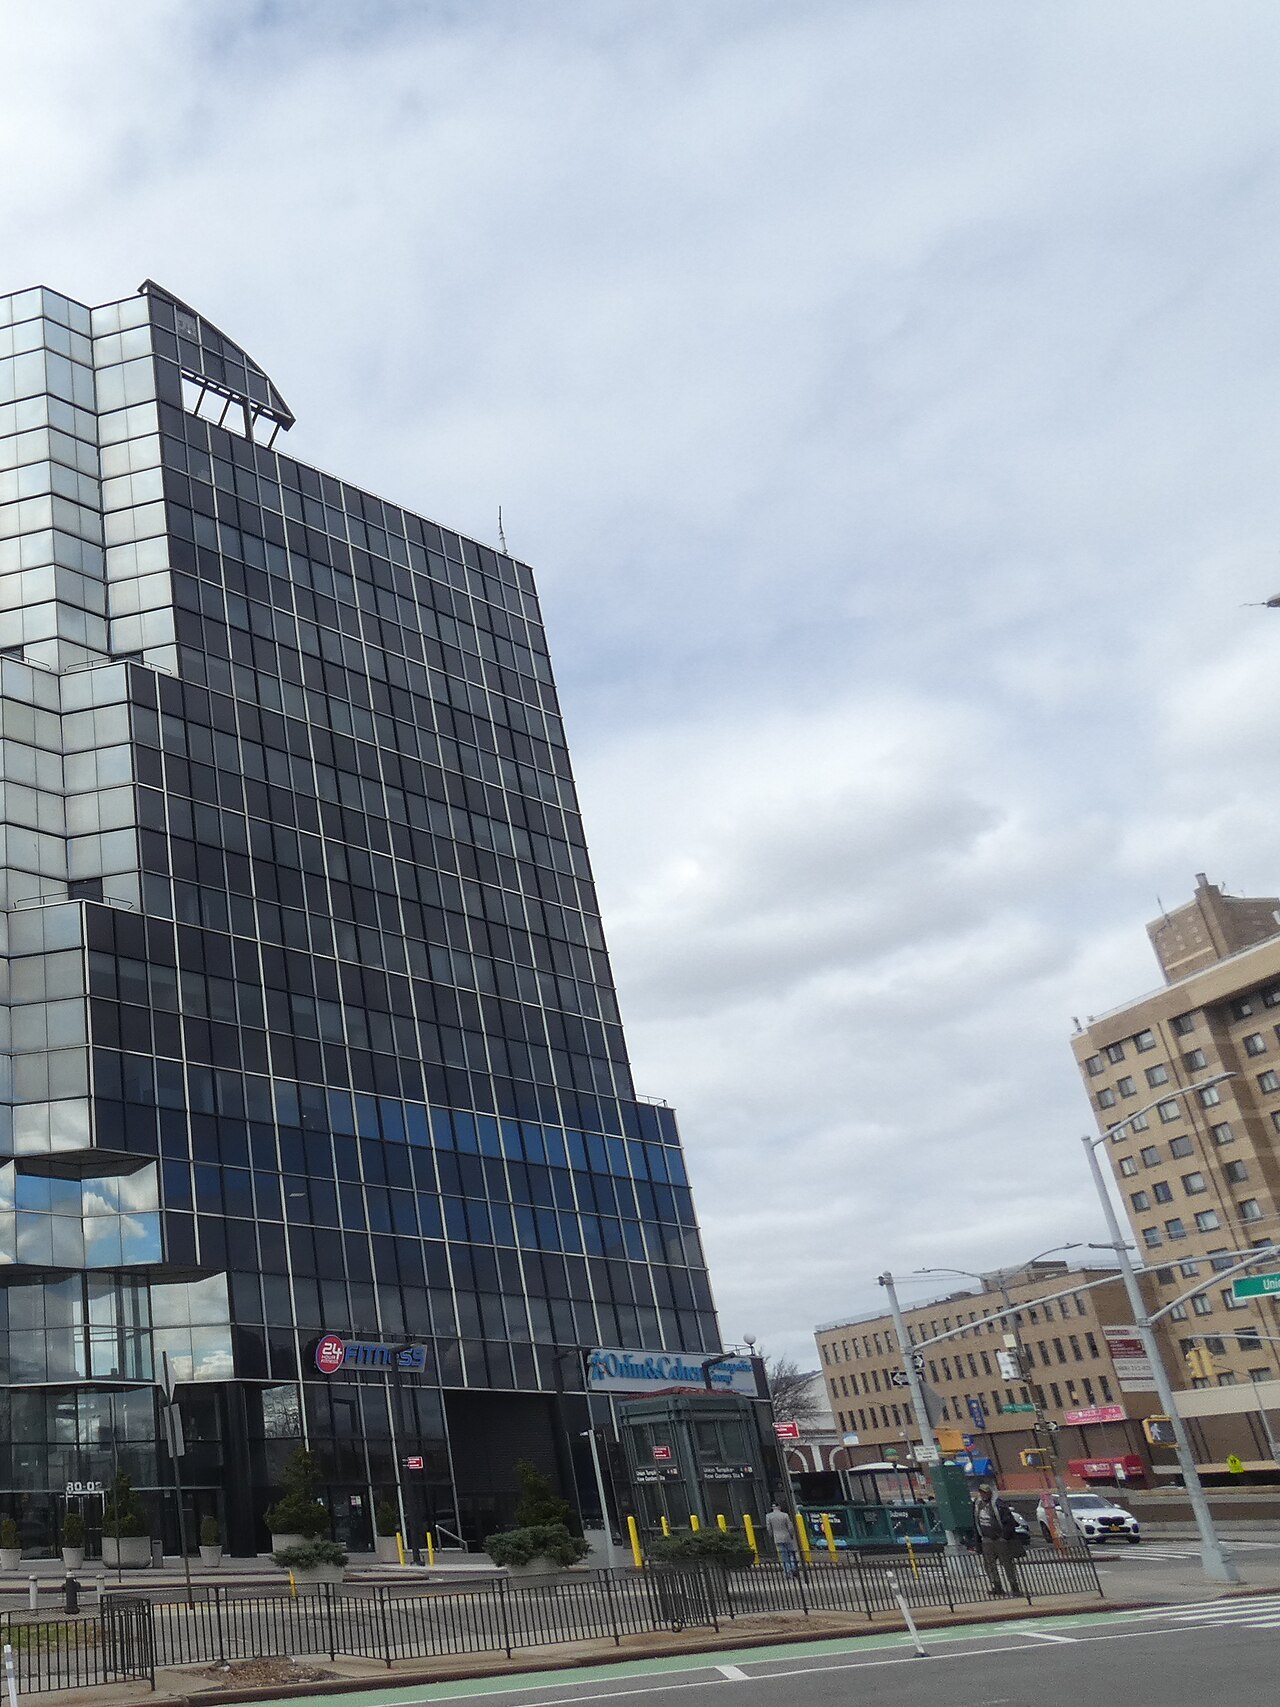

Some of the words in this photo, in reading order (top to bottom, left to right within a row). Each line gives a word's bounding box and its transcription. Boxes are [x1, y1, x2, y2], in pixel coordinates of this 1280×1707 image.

[322, 1342, 343, 1360] 24
[344, 1344, 425, 1367] FITNSS
[66, 1481, 103, 1492] 80-02
